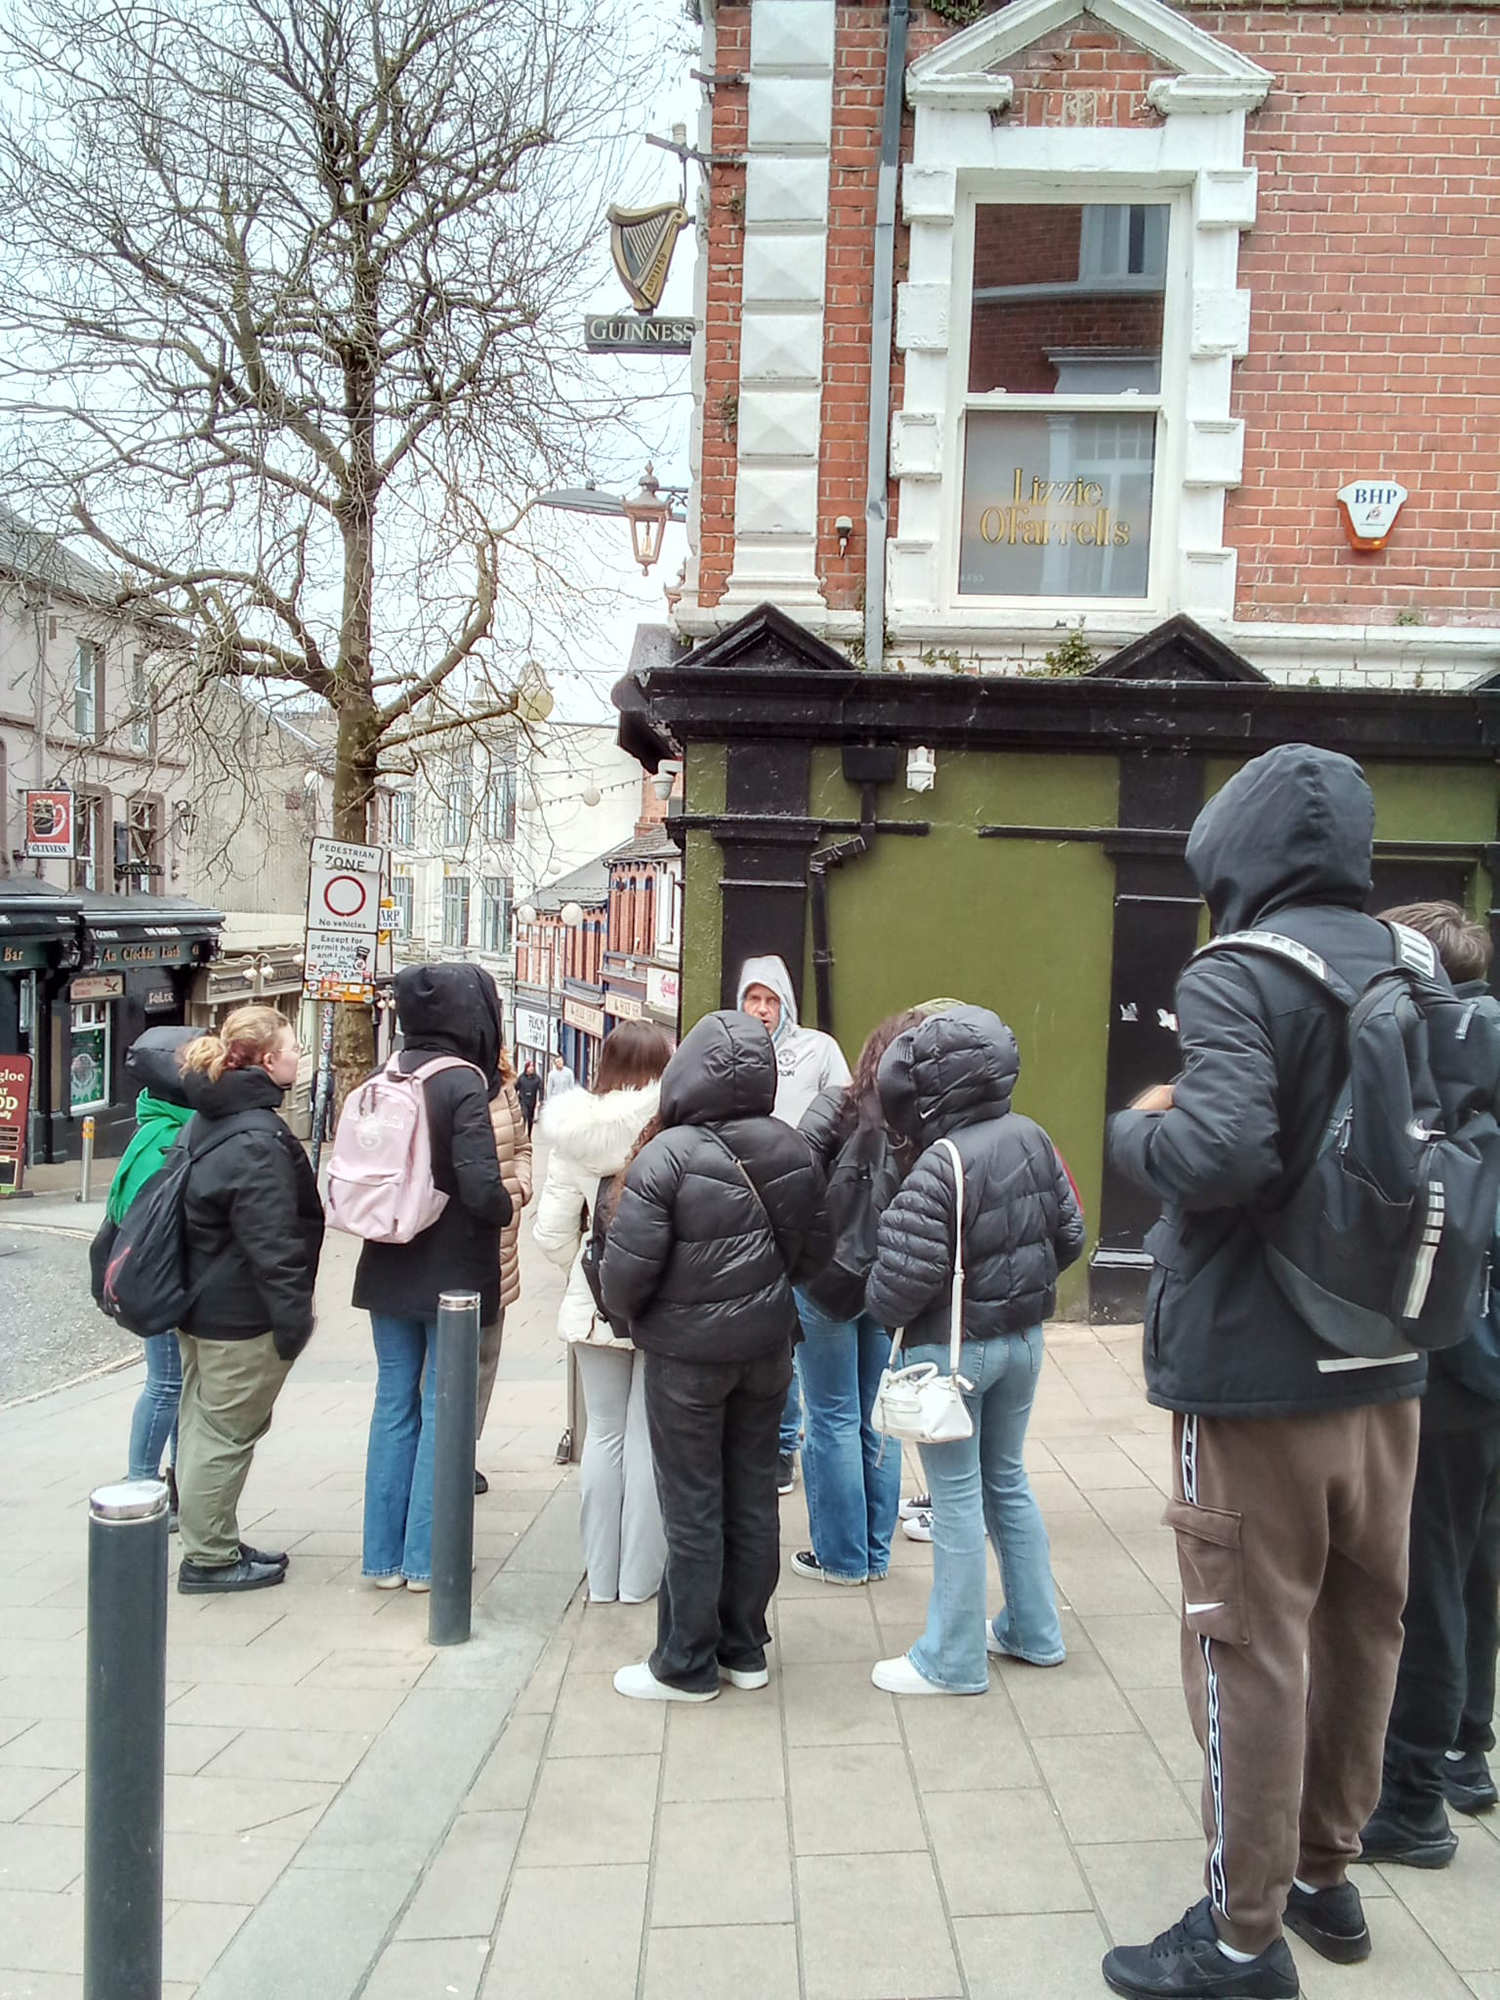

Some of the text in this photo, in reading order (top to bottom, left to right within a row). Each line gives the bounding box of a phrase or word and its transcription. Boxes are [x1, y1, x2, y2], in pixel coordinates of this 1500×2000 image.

[590, 319, 693, 341] GUINNESS
[1014, 468, 1103, 506] Lizzie
[1354, 488, 1397, 505] BHP
[32, 844, 67, 853] GUINNESS
[319, 843, 375, 859] PEDESTRIAN
[325, 854, 367, 873] ZONE
[319, 918, 367, 929] No vehicles
[321, 934, 349, 944] Except
[4, 947, 24, 962] Bar
[311, 943, 338, 951] permit
[103, 949, 117, 961] An
